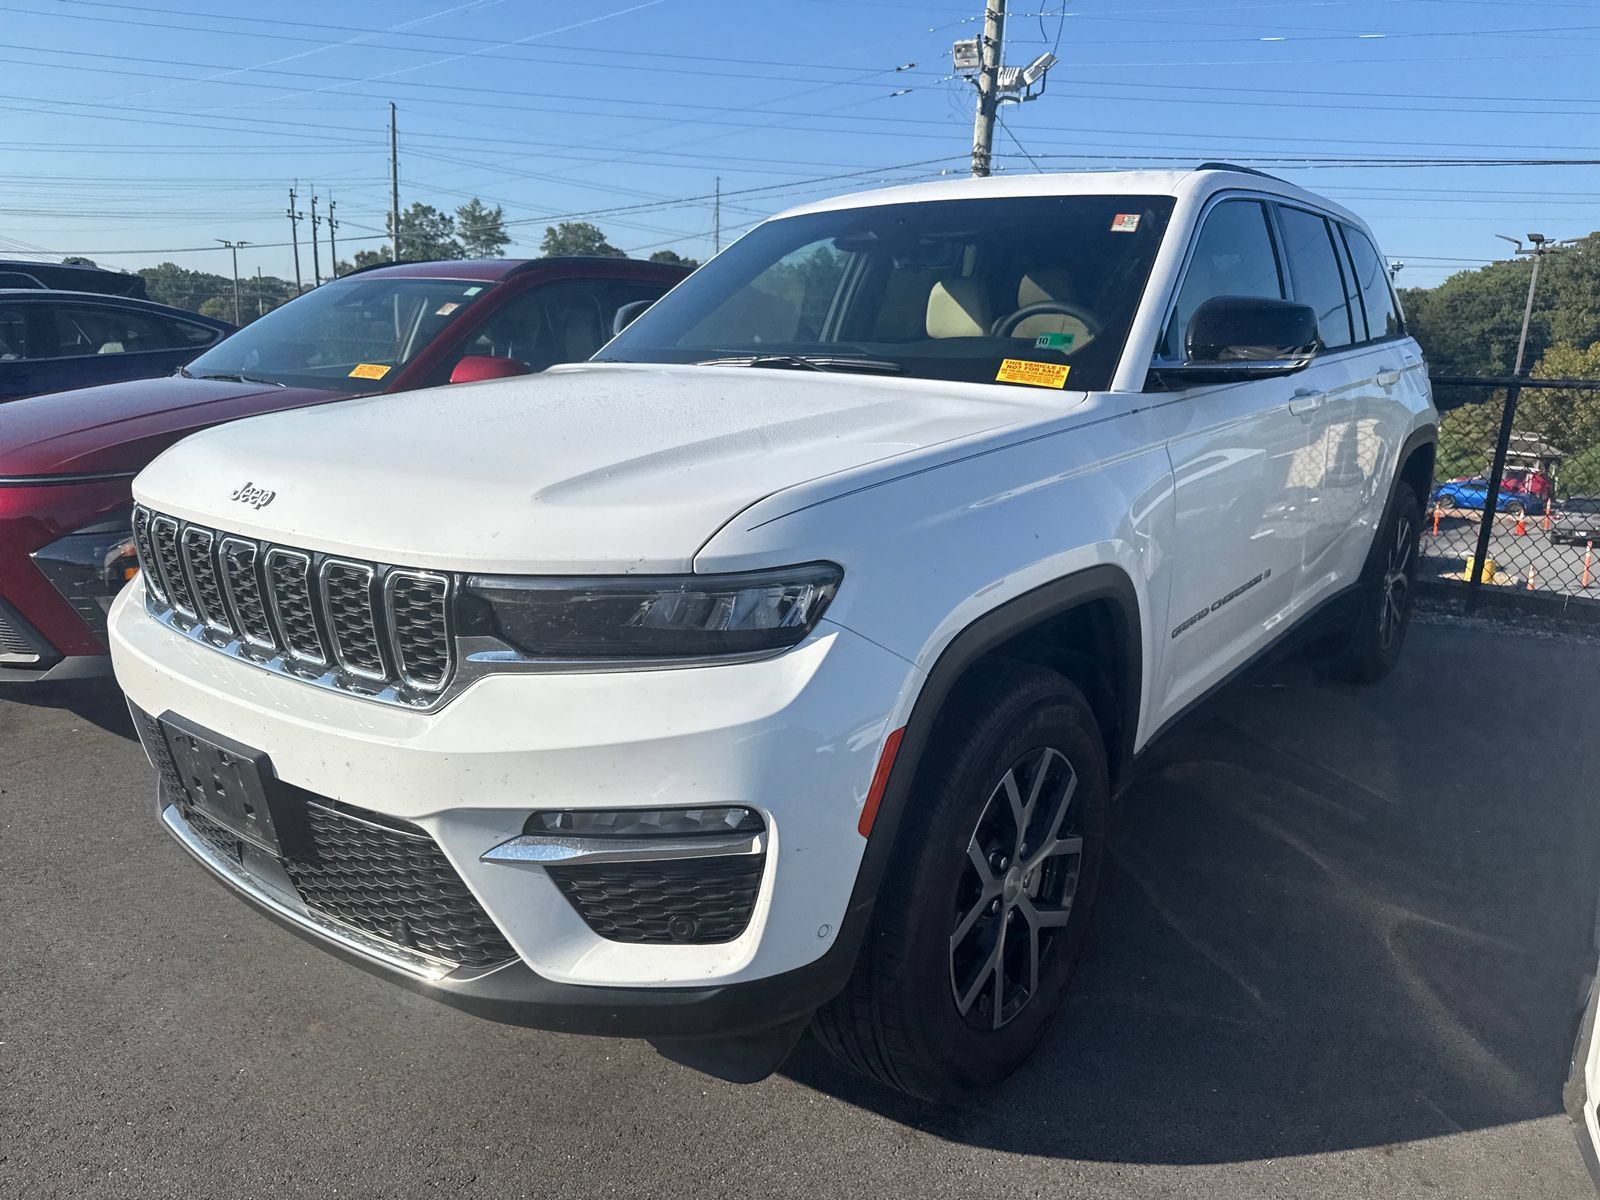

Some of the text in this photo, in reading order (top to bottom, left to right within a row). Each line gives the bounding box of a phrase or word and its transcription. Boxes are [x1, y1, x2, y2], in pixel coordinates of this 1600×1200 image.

[1038, 337, 1049, 345] 10
[1024, 362, 1057, 370] VEHICLE
[231, 481, 277, 510] Jeep
